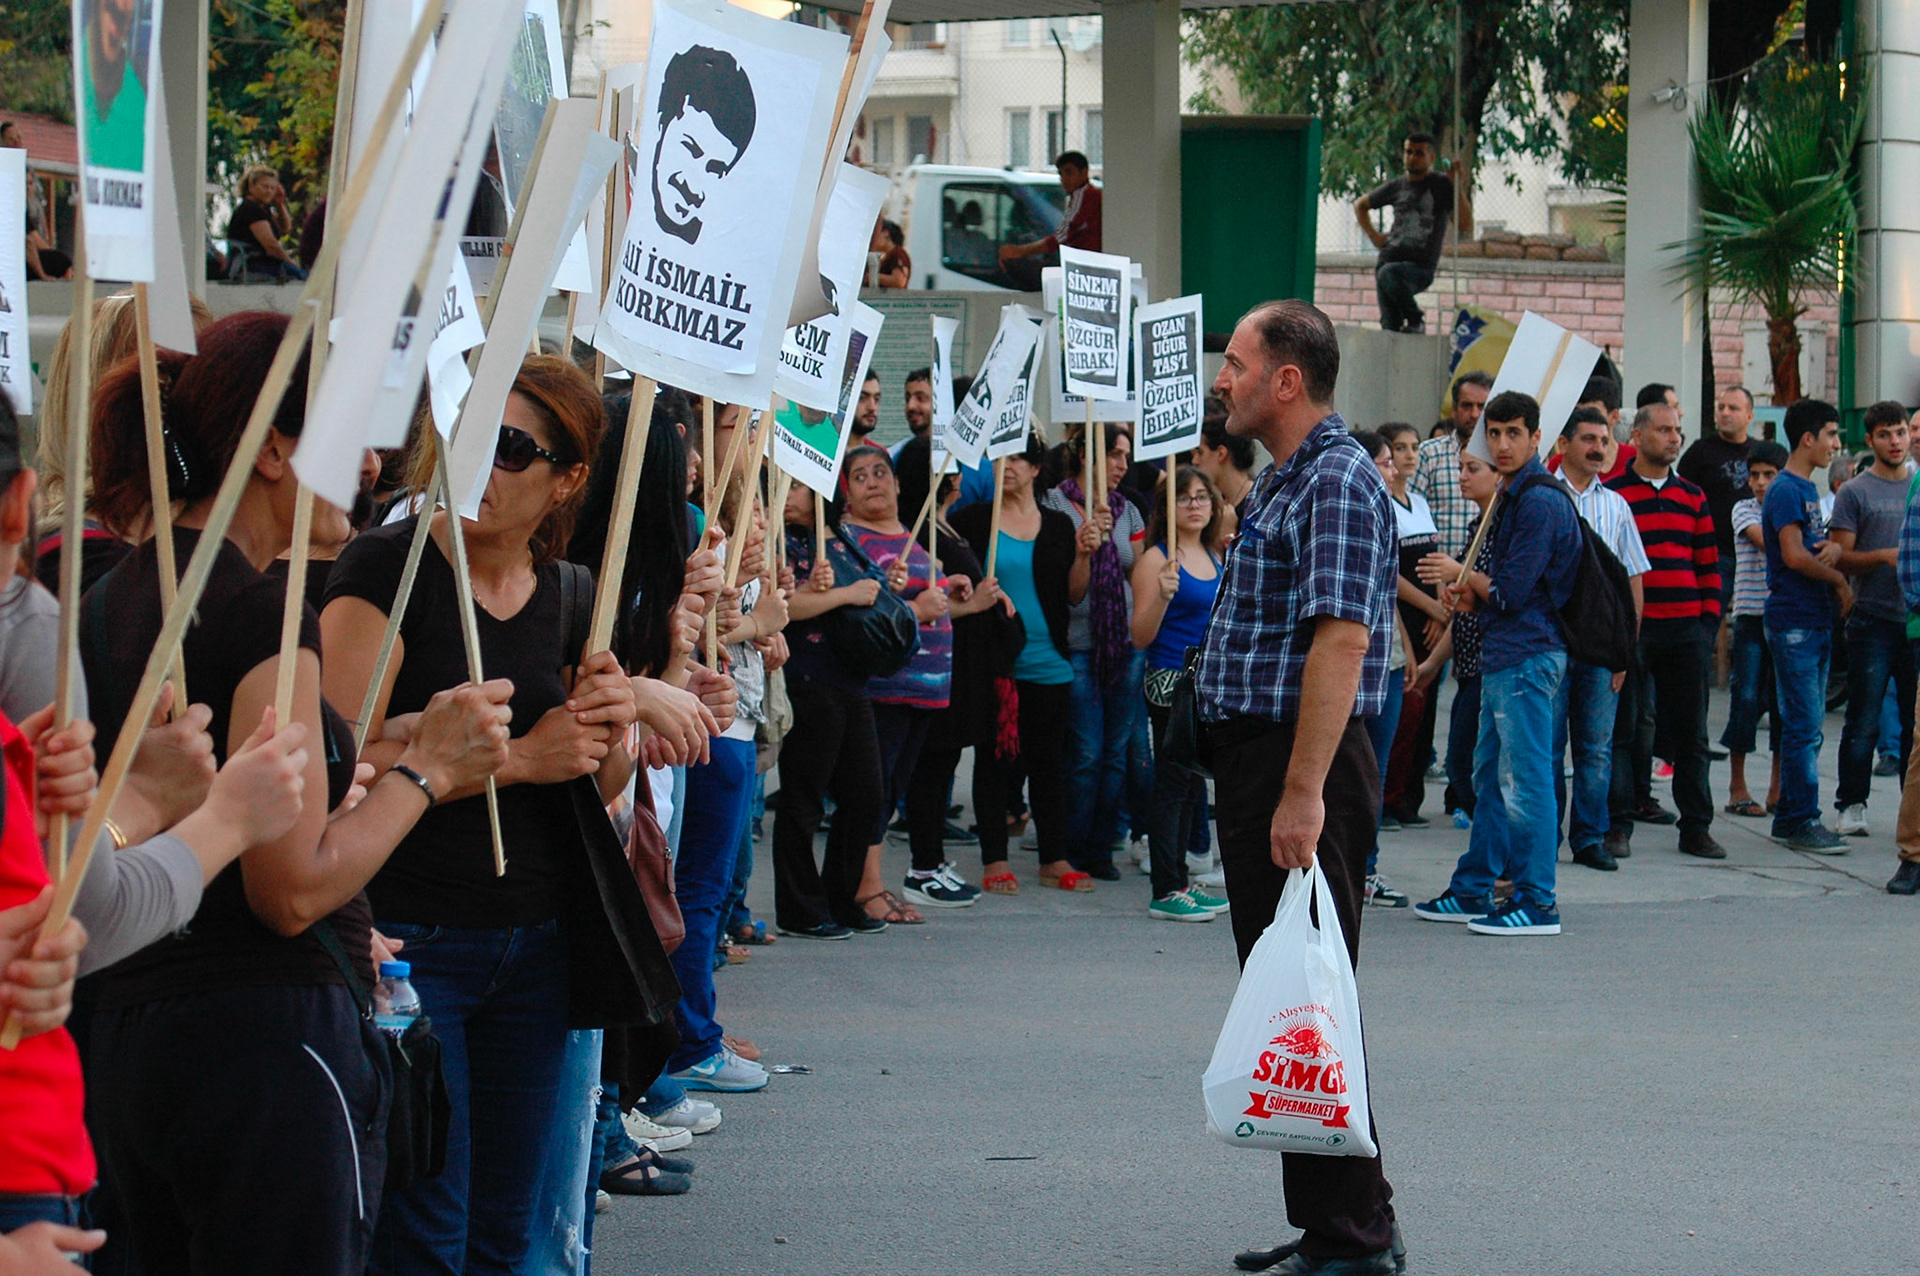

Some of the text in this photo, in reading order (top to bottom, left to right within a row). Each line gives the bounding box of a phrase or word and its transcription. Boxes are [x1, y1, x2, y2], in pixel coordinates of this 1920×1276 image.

[645, 247, 752, 314] İSMAİL
[1068, 269, 1119, 296] SİNEM
[615, 275, 746, 350] KORKMAZ
[1152, 316, 1186, 338] OZAN
[1152, 335, 1188, 357] UĞUR
[1070, 351, 1114, 370] BIRAK!
[1146, 377, 1194, 407] ÖZGÜR
[1146, 400, 1195, 436] BIRAK!
[804, 446, 833, 473] KOKMAZ
[1268, 1095, 1336, 1118] SÜPERMARKET
